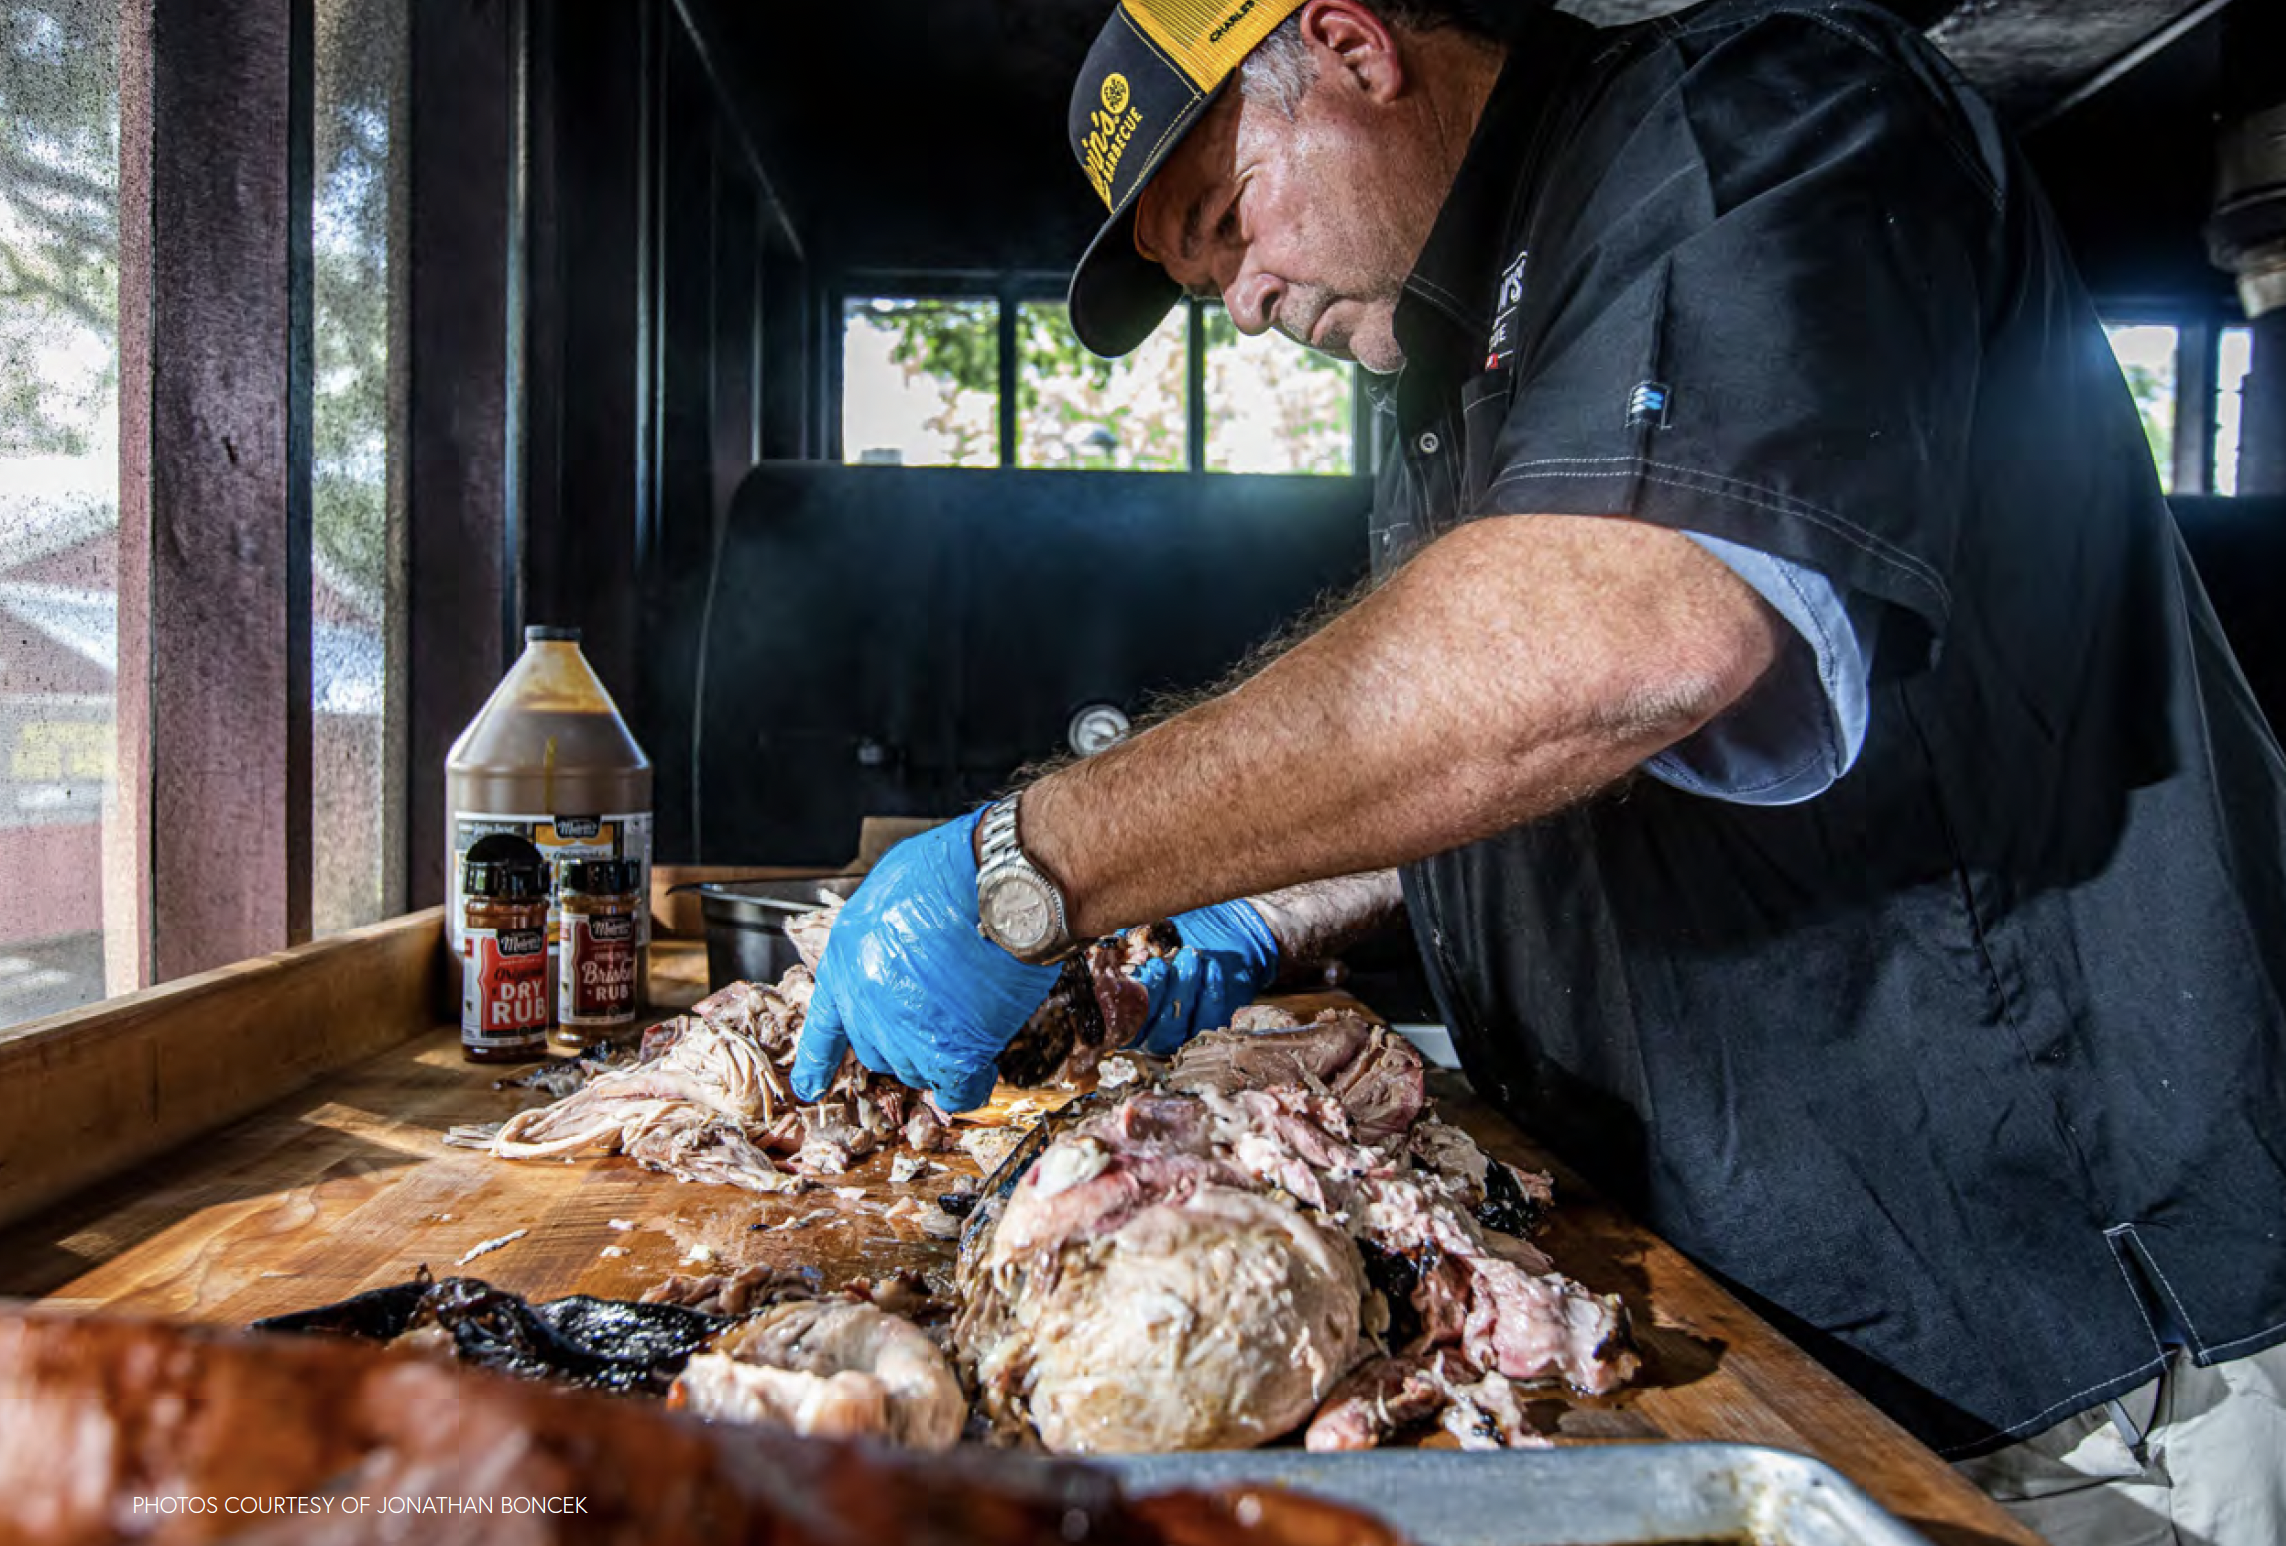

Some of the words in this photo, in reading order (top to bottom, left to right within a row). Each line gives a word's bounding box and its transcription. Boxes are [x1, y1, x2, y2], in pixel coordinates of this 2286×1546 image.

[500, 980, 543, 1001] DRY
[595, 983, 629, 1001] RUB
[491, 997, 547, 1025] RUB
